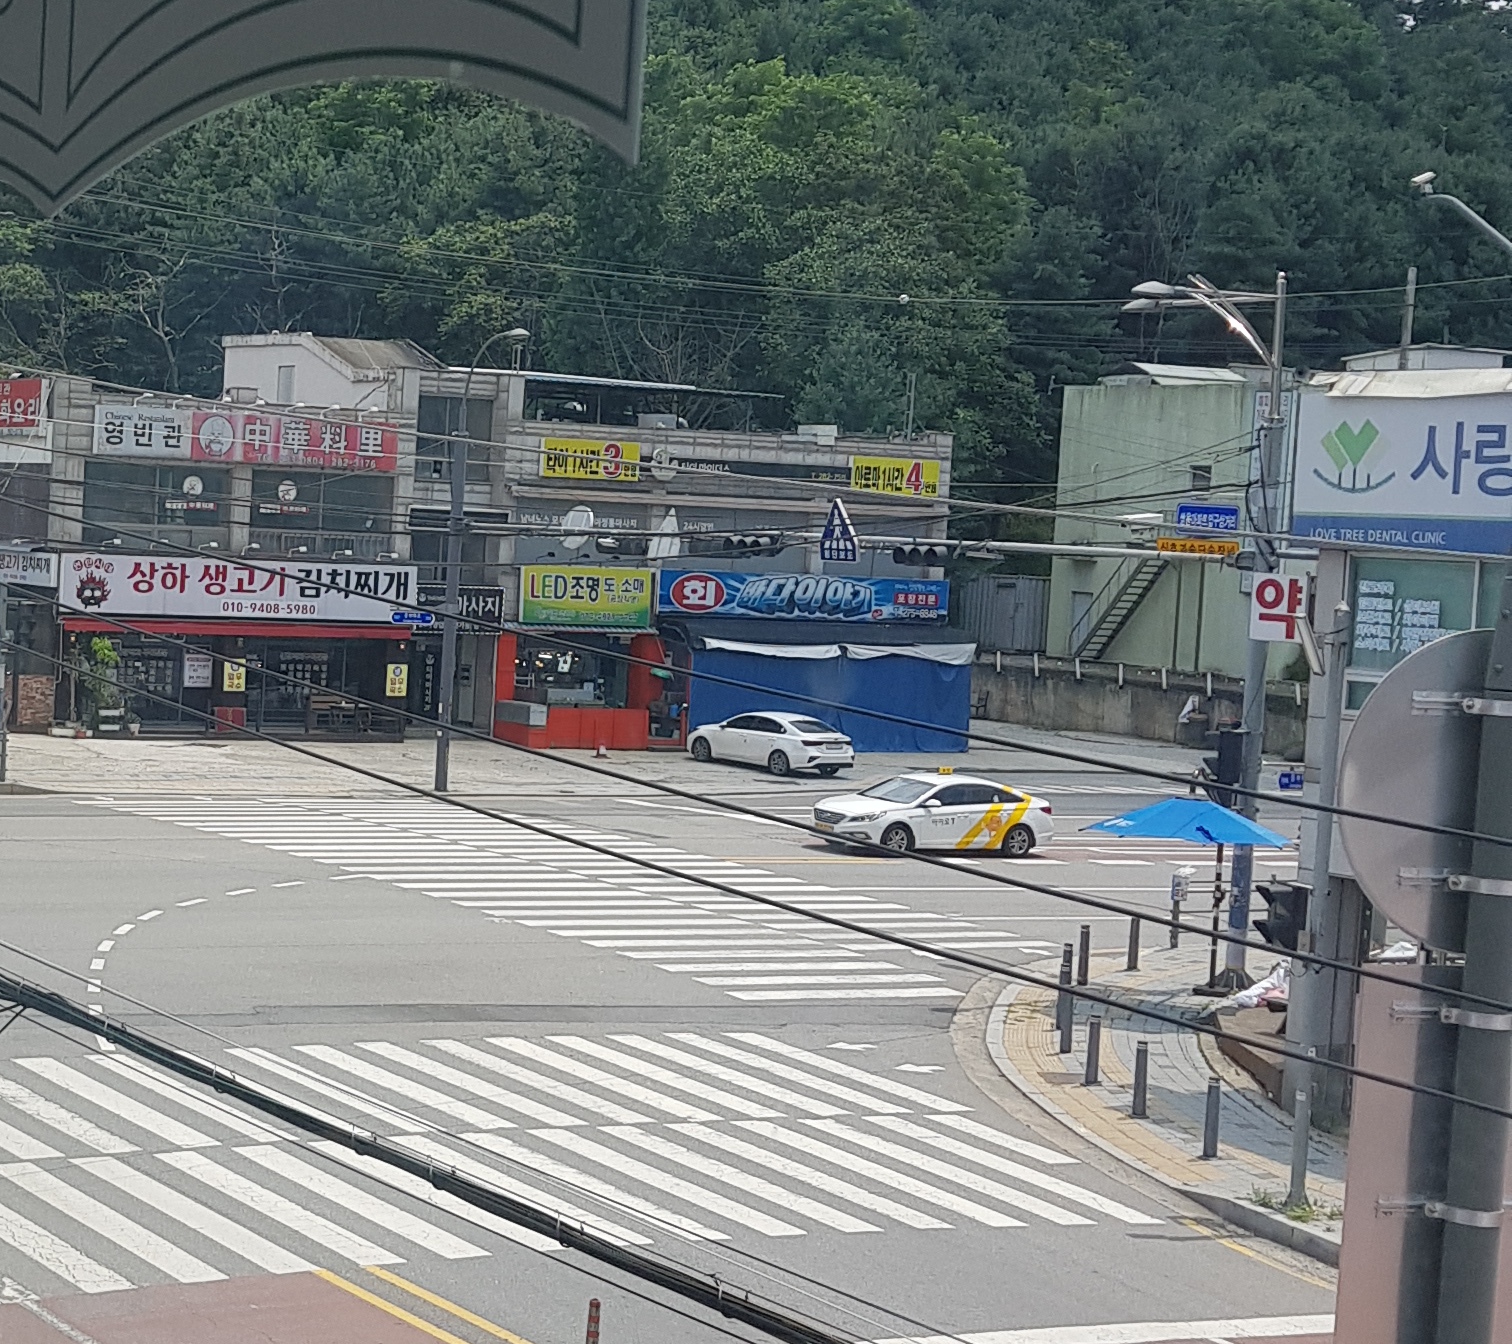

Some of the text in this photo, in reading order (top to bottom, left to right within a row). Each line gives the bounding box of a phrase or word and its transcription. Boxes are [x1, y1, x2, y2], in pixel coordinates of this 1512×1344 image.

[104, 421, 182, 448] 영빈관
[244, 418, 385, 457] 中華料里
[1310, 528, 1447, 545] LOVE TREE DENTAL CLINIC
[126, 560, 409, 601] 상하 생고기 김치찌개
[682, 580, 716, 606] 회
[737, 576, 872, 616] 바다이야기
[222, 601, 316, 615] 010-9408-5980
[1255, 578, 1304, 640] 약
